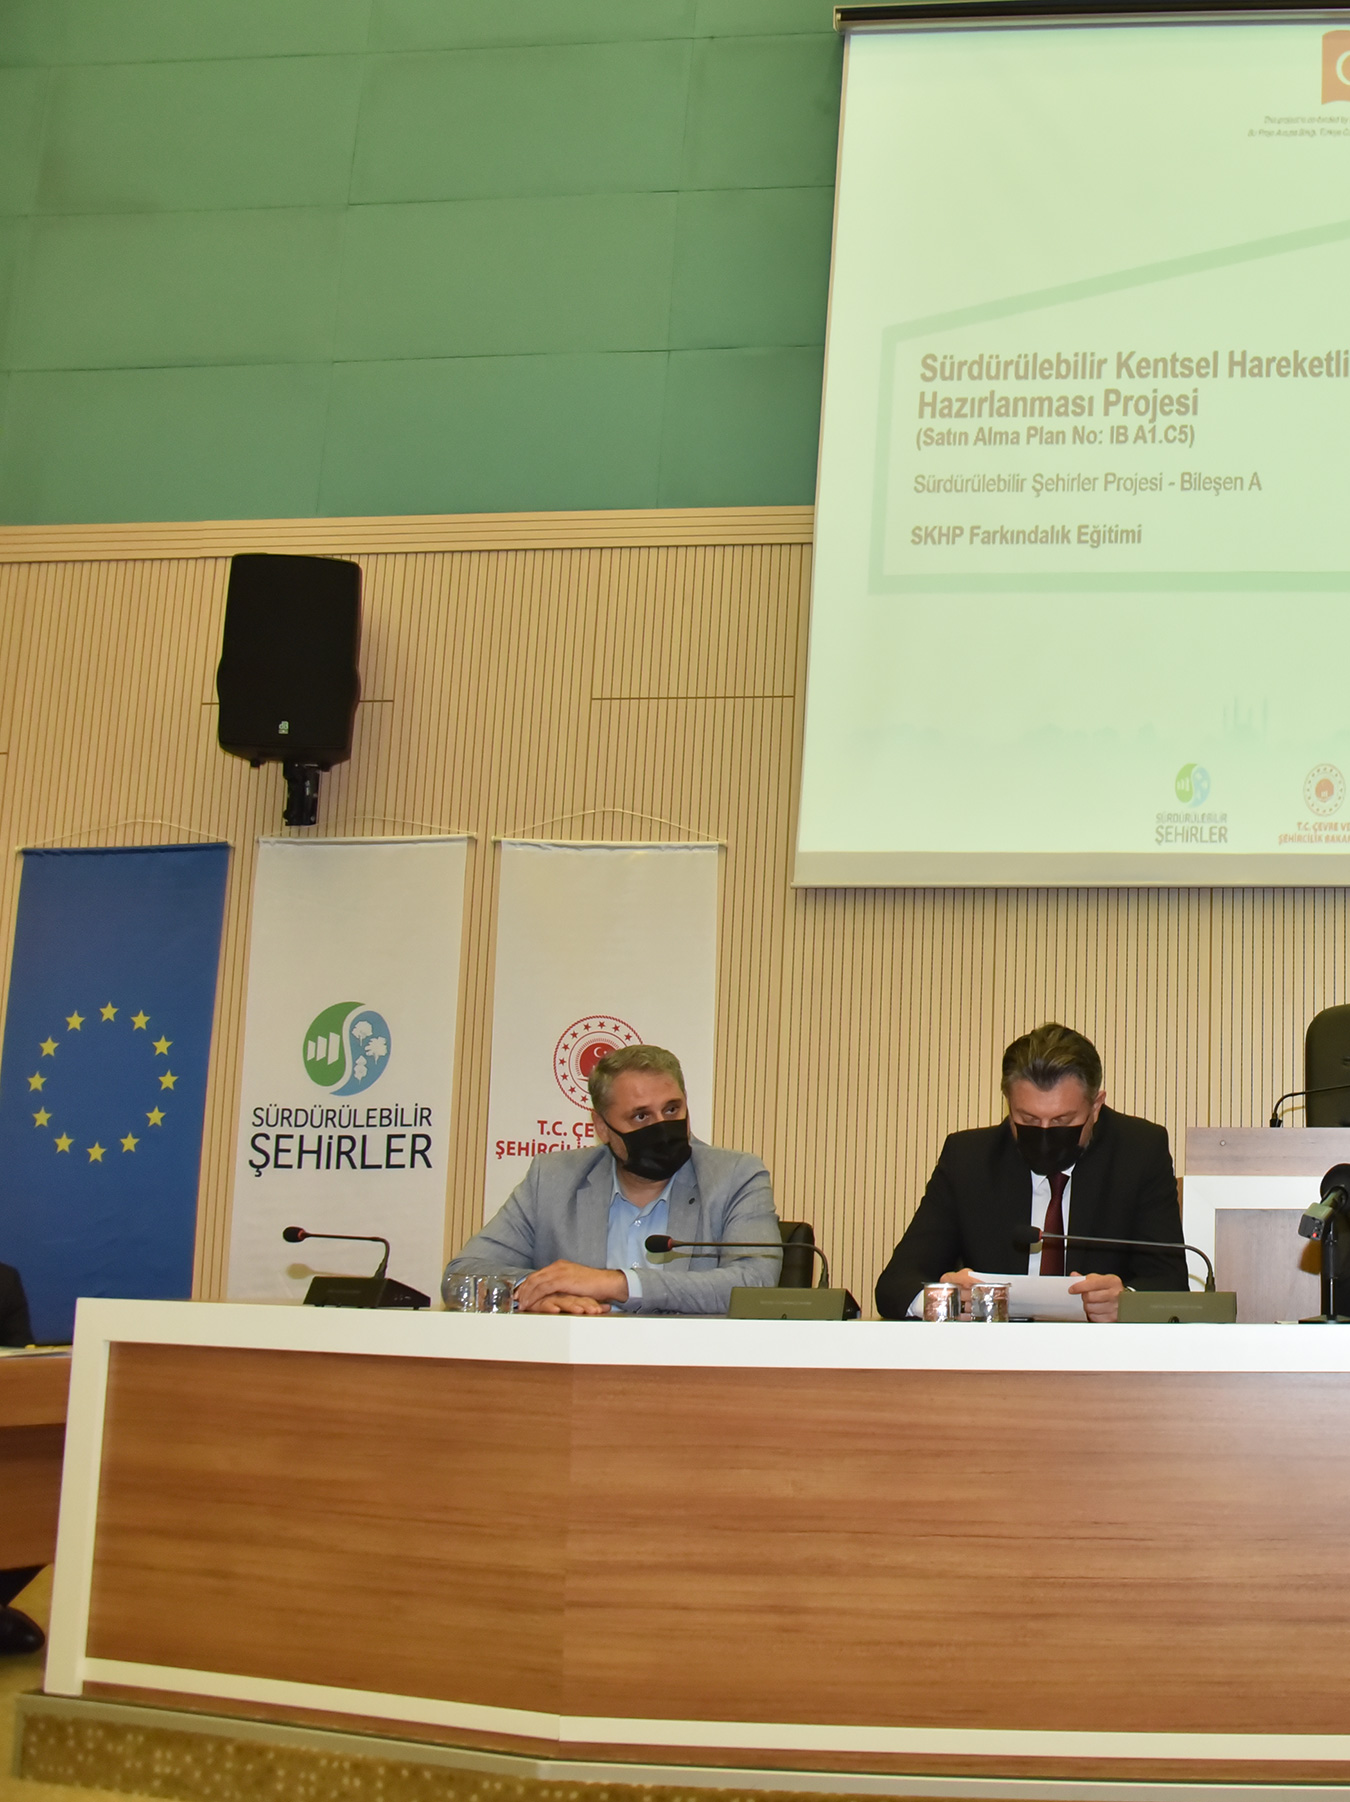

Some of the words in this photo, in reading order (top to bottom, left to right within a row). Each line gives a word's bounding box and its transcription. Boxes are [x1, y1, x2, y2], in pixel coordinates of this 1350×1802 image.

[920, 352, 1108, 382] Sürdürülebilir
[1116, 350, 1218, 379] Kentsel
[918, 390, 1094, 419] Hazırlanması
[1103, 388, 1199, 424] Projesi
[916, 427, 969, 450] (Satın
[974, 426, 1020, 446] Alma
[1026, 426, 1066, 446] Plan
[1072, 426, 1103, 445] No:
[1110, 425, 1129, 444] IB
[1133, 424, 1195, 448] A1.C5)
[913, 474, 1027, 494] Sürdürülebilir
[1032, 472, 1099, 498] Şehirler
[1104, 472, 1164, 496] Projesi
[1180, 472, 1244, 496] Bileşen
[1248, 472, 1262, 491] A
[910, 526, 964, 546] SKHP
[969, 525, 1072, 545] Farkındalık
[1076, 524, 1143, 549] Eğitimi
[252, 1103, 432, 1128] SÜRDÜRÜLEBİLİR
[537, 1120, 568, 1136] T.C.
[572, 1122, 594, 1142] ÇE
